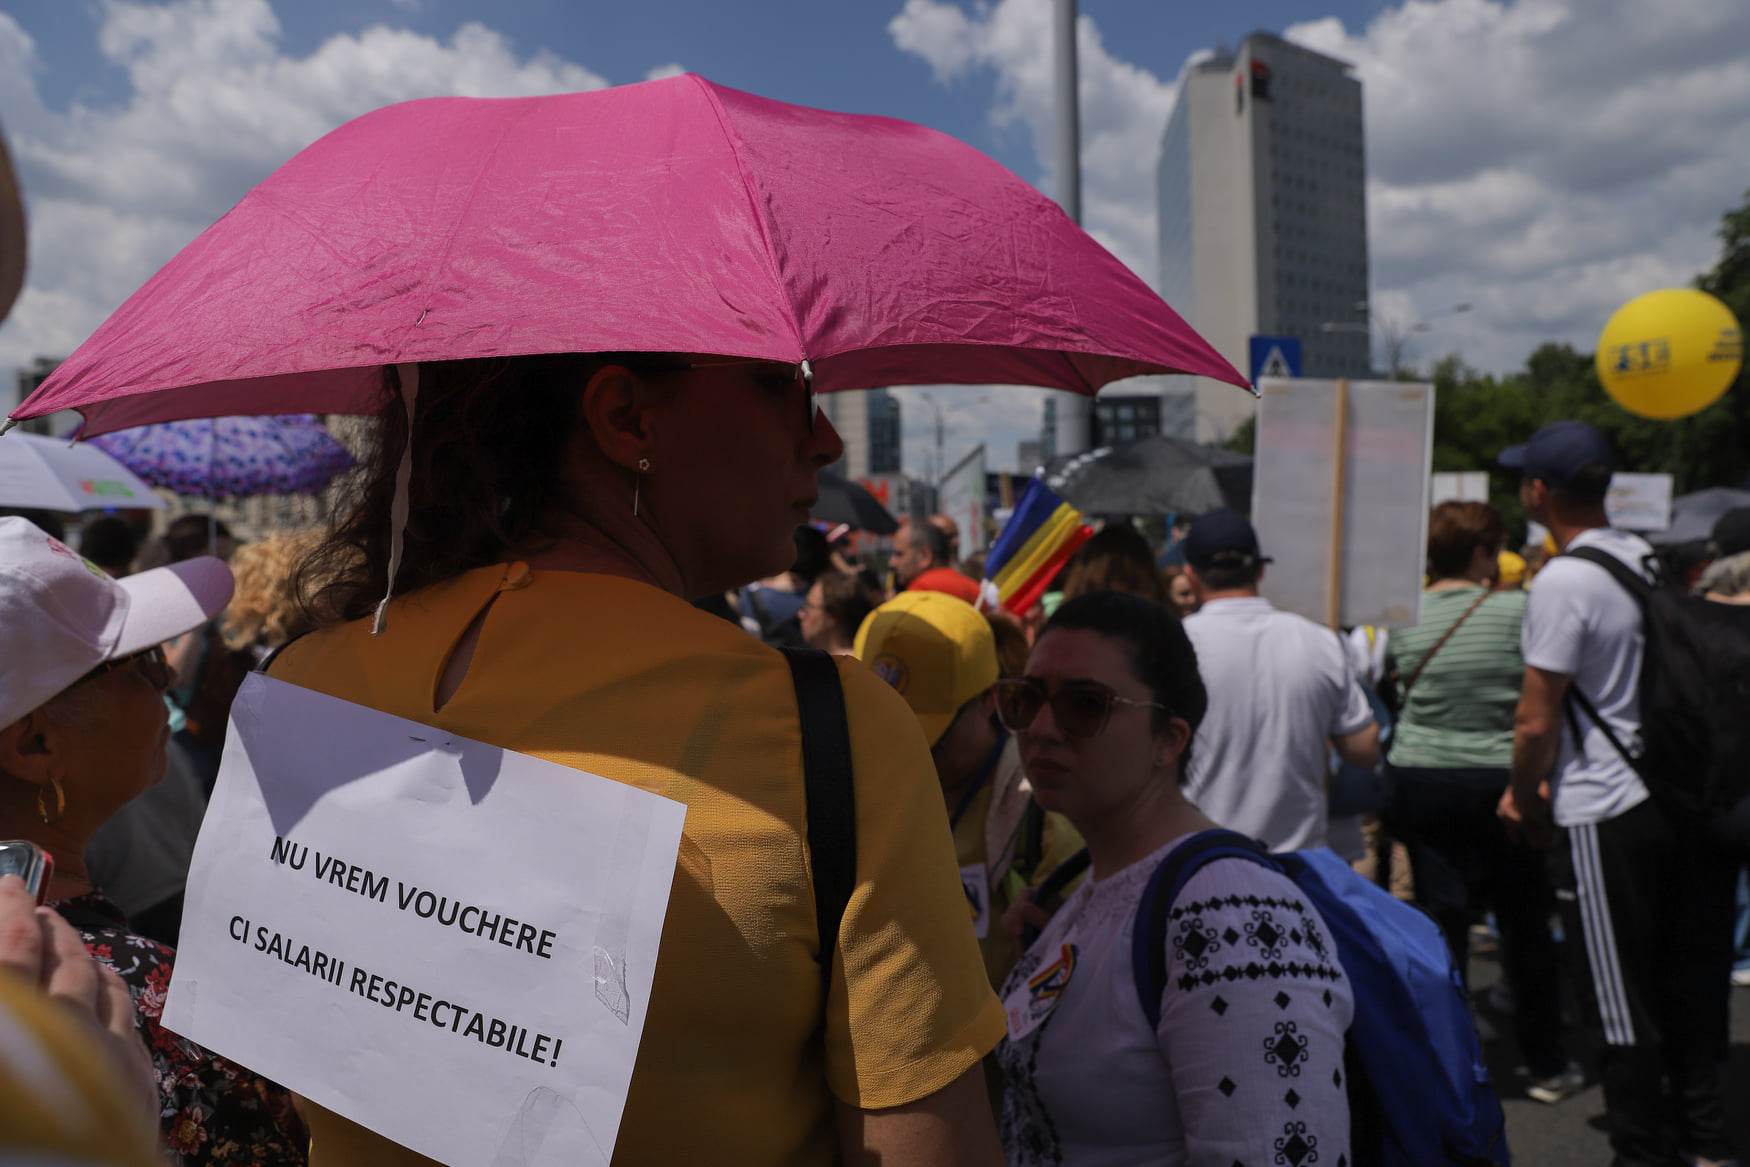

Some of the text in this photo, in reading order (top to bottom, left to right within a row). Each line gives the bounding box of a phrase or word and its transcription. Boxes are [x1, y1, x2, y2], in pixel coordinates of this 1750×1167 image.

[270, 835, 557, 960] NU VREM VOUCHERE
[229, 915, 563, 1068] CI SALARII RESPECTABILE!
